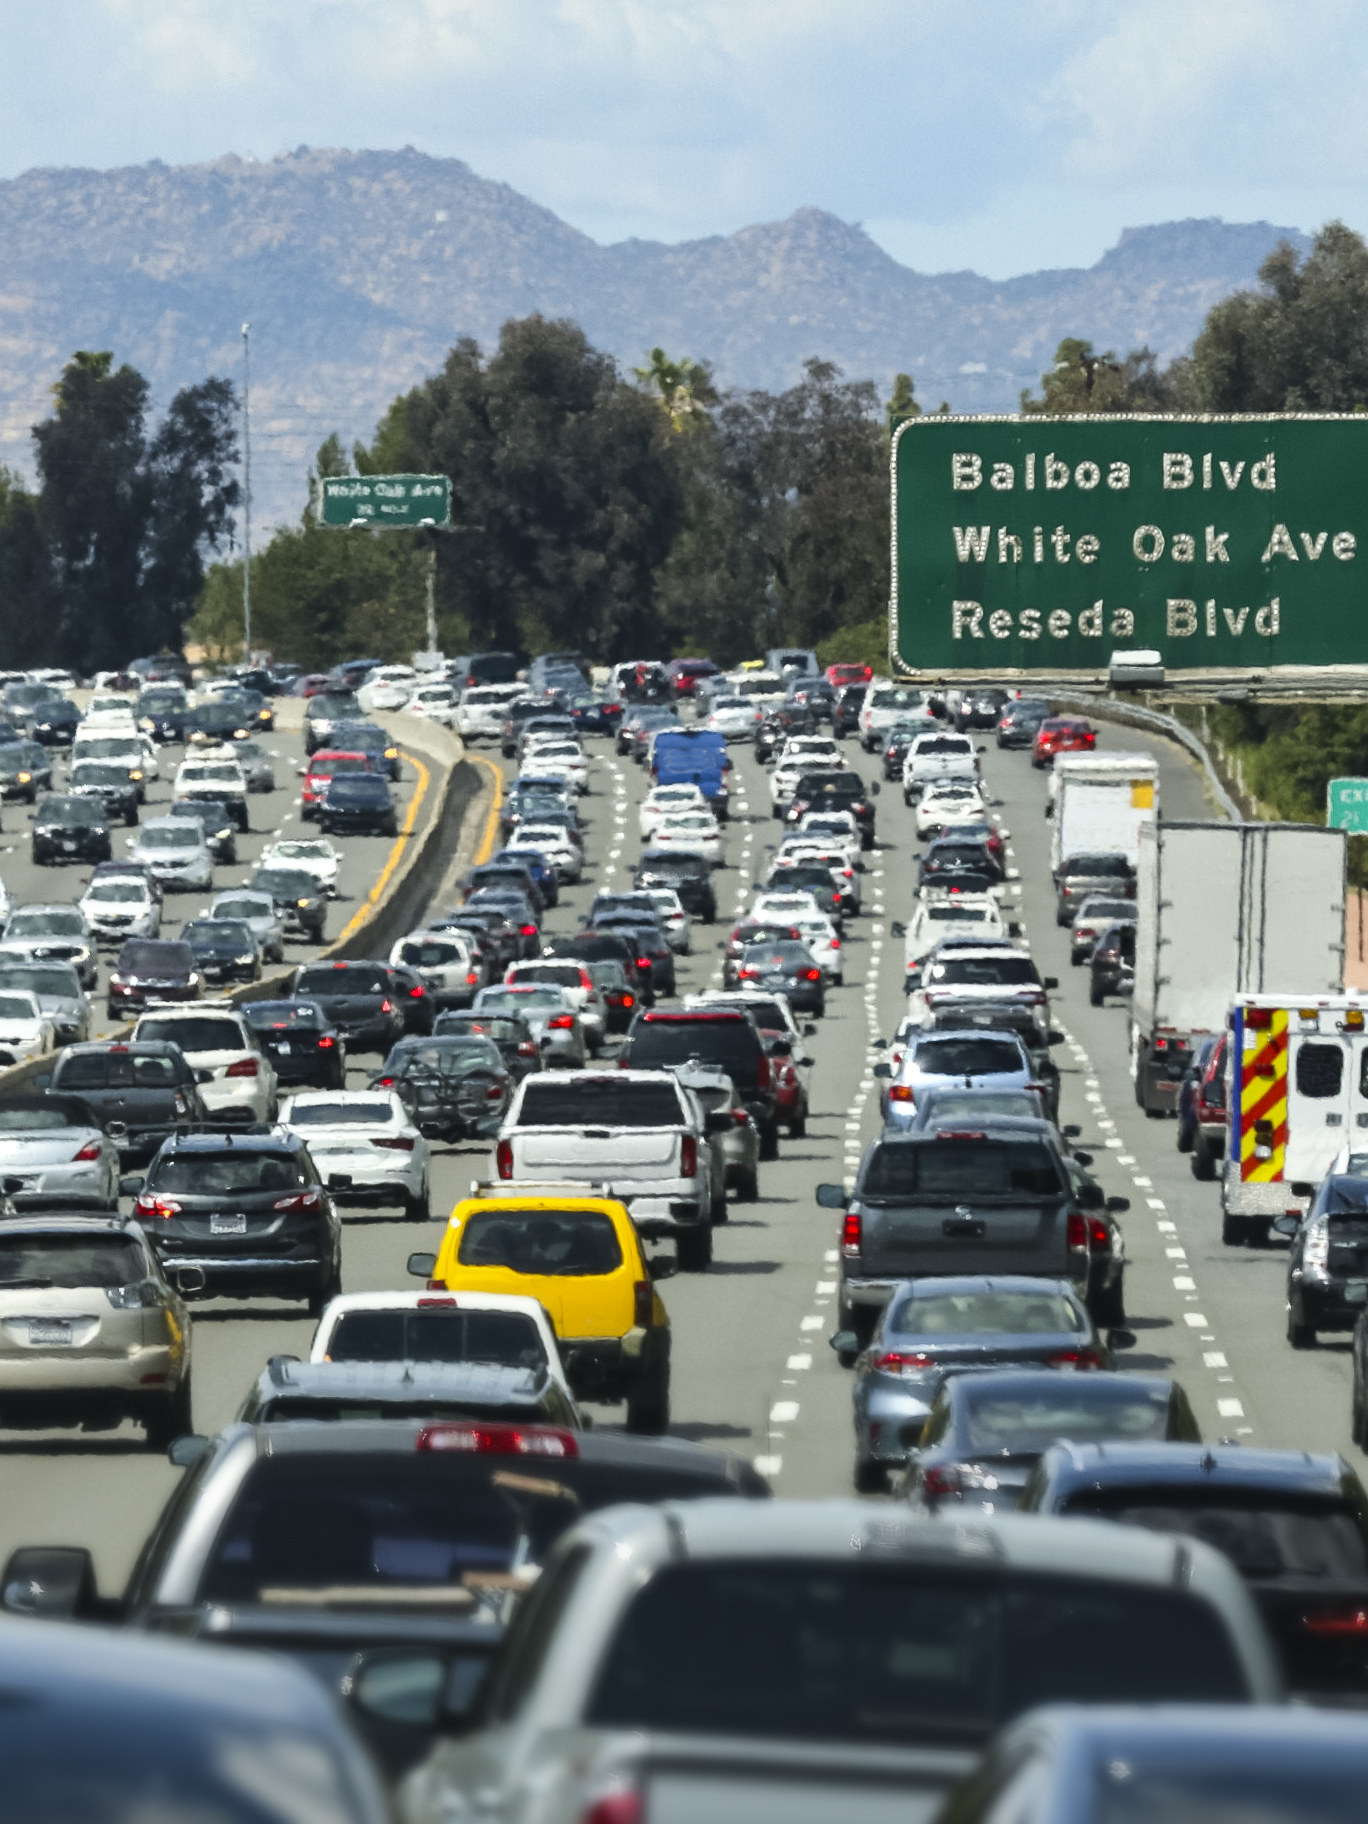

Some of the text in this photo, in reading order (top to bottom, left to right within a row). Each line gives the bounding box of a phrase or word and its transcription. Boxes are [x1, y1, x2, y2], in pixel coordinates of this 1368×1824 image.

[952, 451, 1277, 492] Balboa Blvd
[952, 523, 1357, 565] White Oak Ave
[952, 597, 1281, 640] Reseda Blvd
